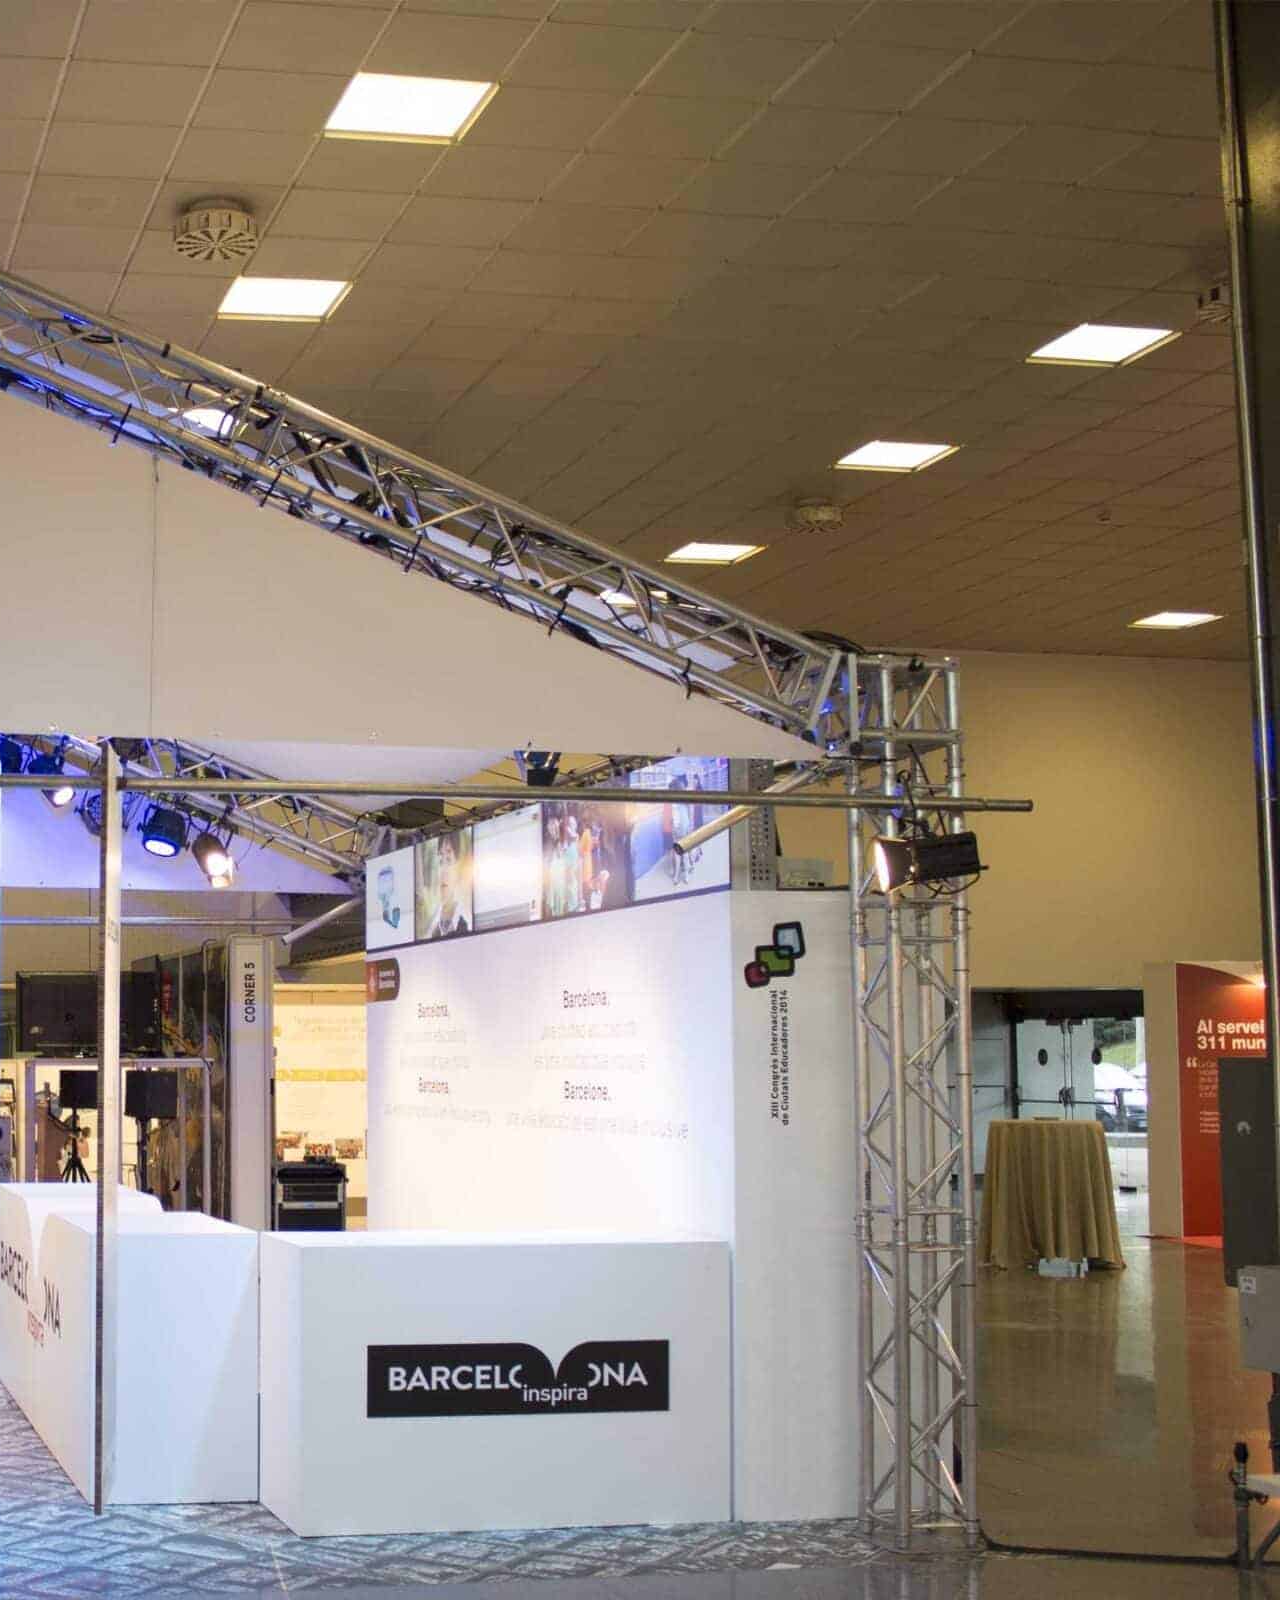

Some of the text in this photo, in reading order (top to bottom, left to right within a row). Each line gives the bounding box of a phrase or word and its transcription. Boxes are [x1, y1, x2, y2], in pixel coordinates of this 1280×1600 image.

[244, 961, 256, 1023] CORNER 5
[770, 990, 778, 1056] Internacional
[1196, 1019, 1265, 1034] Al servei
[1197, 1035, 1226, 1050] 311
[779, 989, 790, 1126] de Ciutats Educadores 2014
[771, 1101, 779, 1119] XIII
[523, 1383, 588, 1406] inspira
